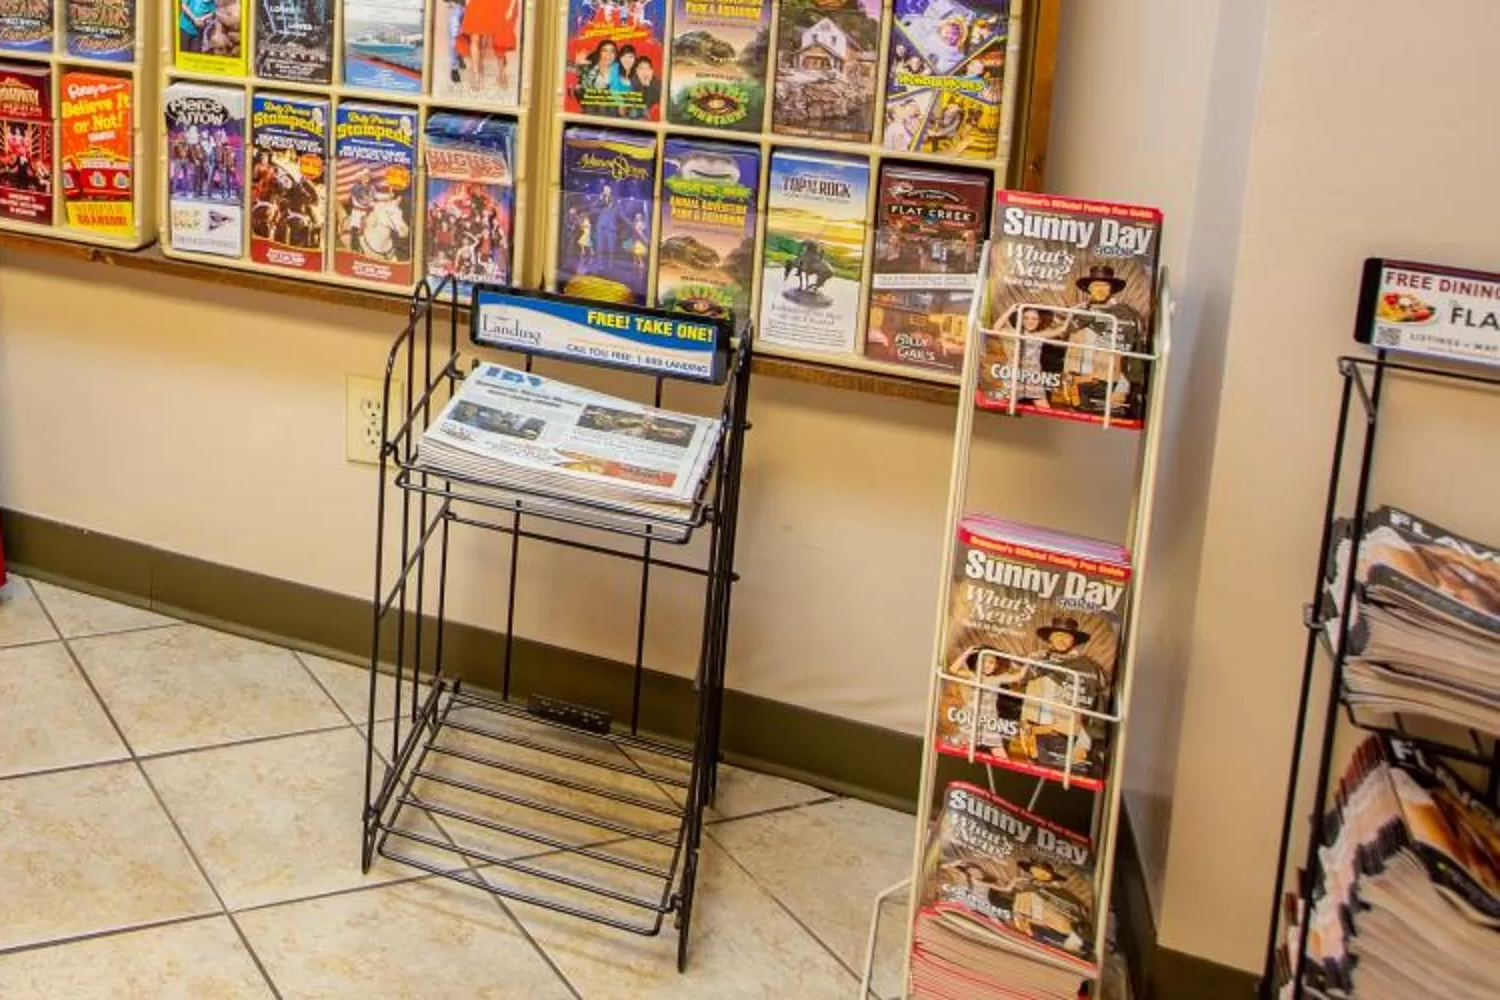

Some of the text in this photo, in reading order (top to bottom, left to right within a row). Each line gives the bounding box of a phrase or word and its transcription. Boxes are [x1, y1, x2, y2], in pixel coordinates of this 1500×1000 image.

[61, 98, 113, 119] Believe
[117, 91, 131, 110] It
[170, 98, 223, 112] Pierce
[175, 110, 224, 127] Arrow
[74, 111, 124, 133] or Not!
[253, 111, 325, 137] Stampede
[336, 123, 413, 147] Stampede
[890, 204, 972, 221] FLAT CREEK
[1003, 206, 1153, 255] Sunny Day
[1007, 241, 1075, 267] What's
[1010, 260, 1071, 282] New?
[482, 313, 543, 345] Landing
[587, 310, 714, 343] FREE! TAKE ONE!
[965, 549, 1125, 612] Sunny Day
[966, 584, 1037, 616] What's
[948, 789, 1088, 865] Sunny Day
[952, 813, 1014, 851] What's
